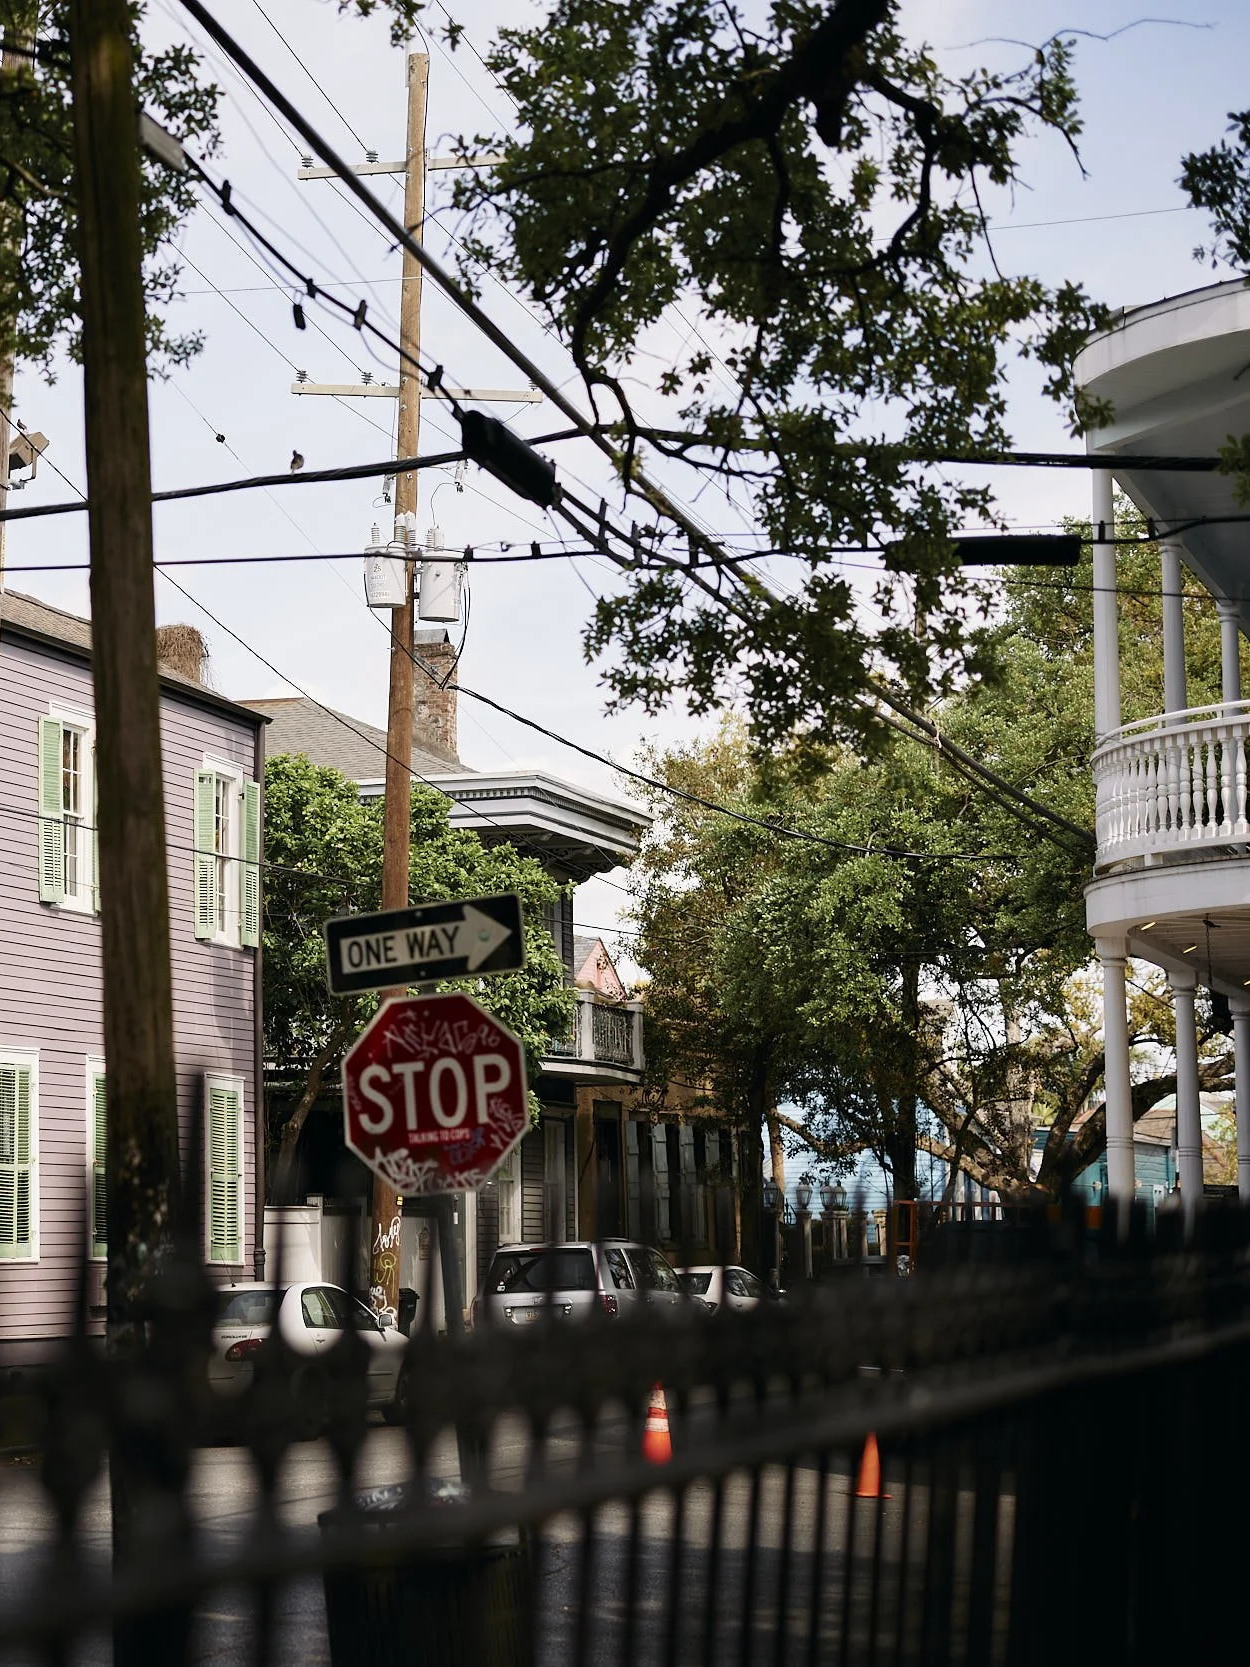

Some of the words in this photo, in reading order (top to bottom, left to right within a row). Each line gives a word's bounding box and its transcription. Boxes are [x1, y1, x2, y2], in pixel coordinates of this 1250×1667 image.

[348, 935, 398, 968] ONE
[406, 925, 460, 960] WAY
[358, 1053, 511, 1135] STOP
[440, 1130, 449, 1141] TO
[450, 1127, 470, 1140] COPS
